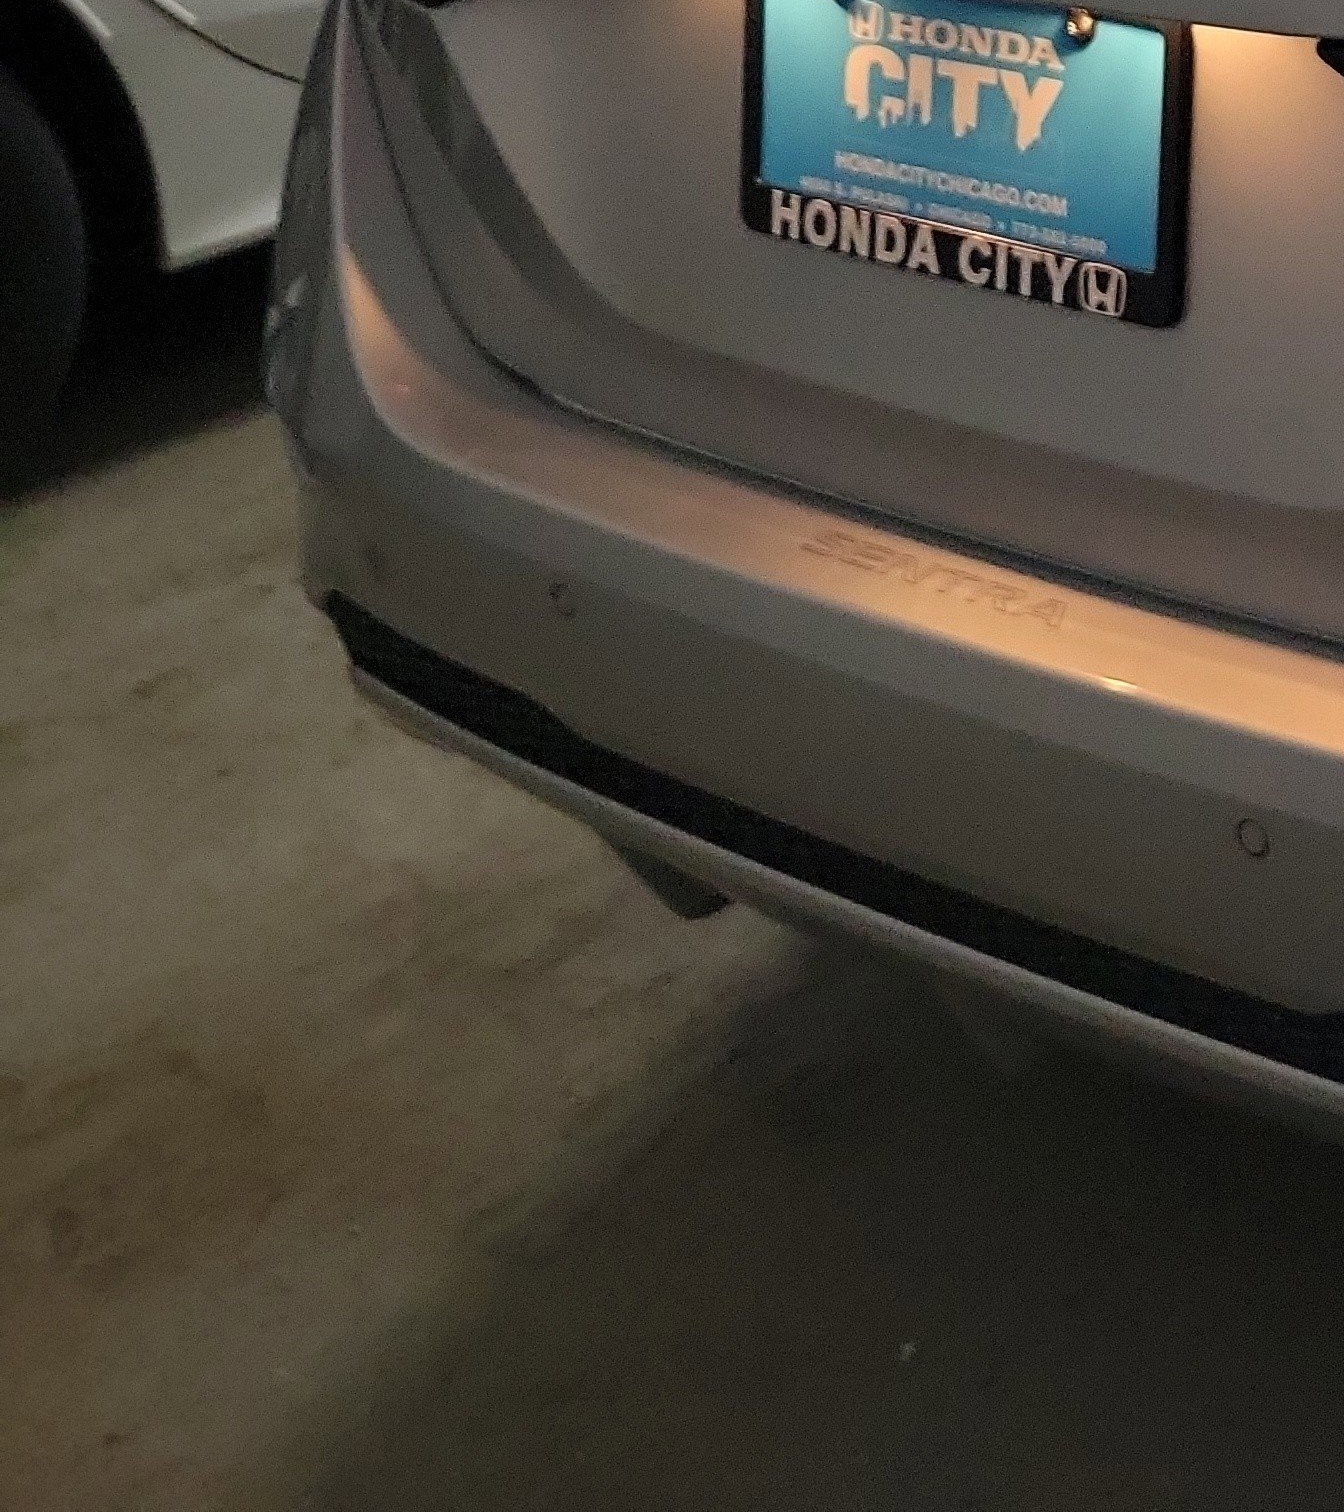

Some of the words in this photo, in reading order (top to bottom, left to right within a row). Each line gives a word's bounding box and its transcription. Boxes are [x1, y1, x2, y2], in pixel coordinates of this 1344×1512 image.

[888, 10, 1066, 71] HONDA
[844, 44, 1064, 152] CITY
[771, 189, 940, 274] HONDA
[958, 235, 1079, 304] CITY
